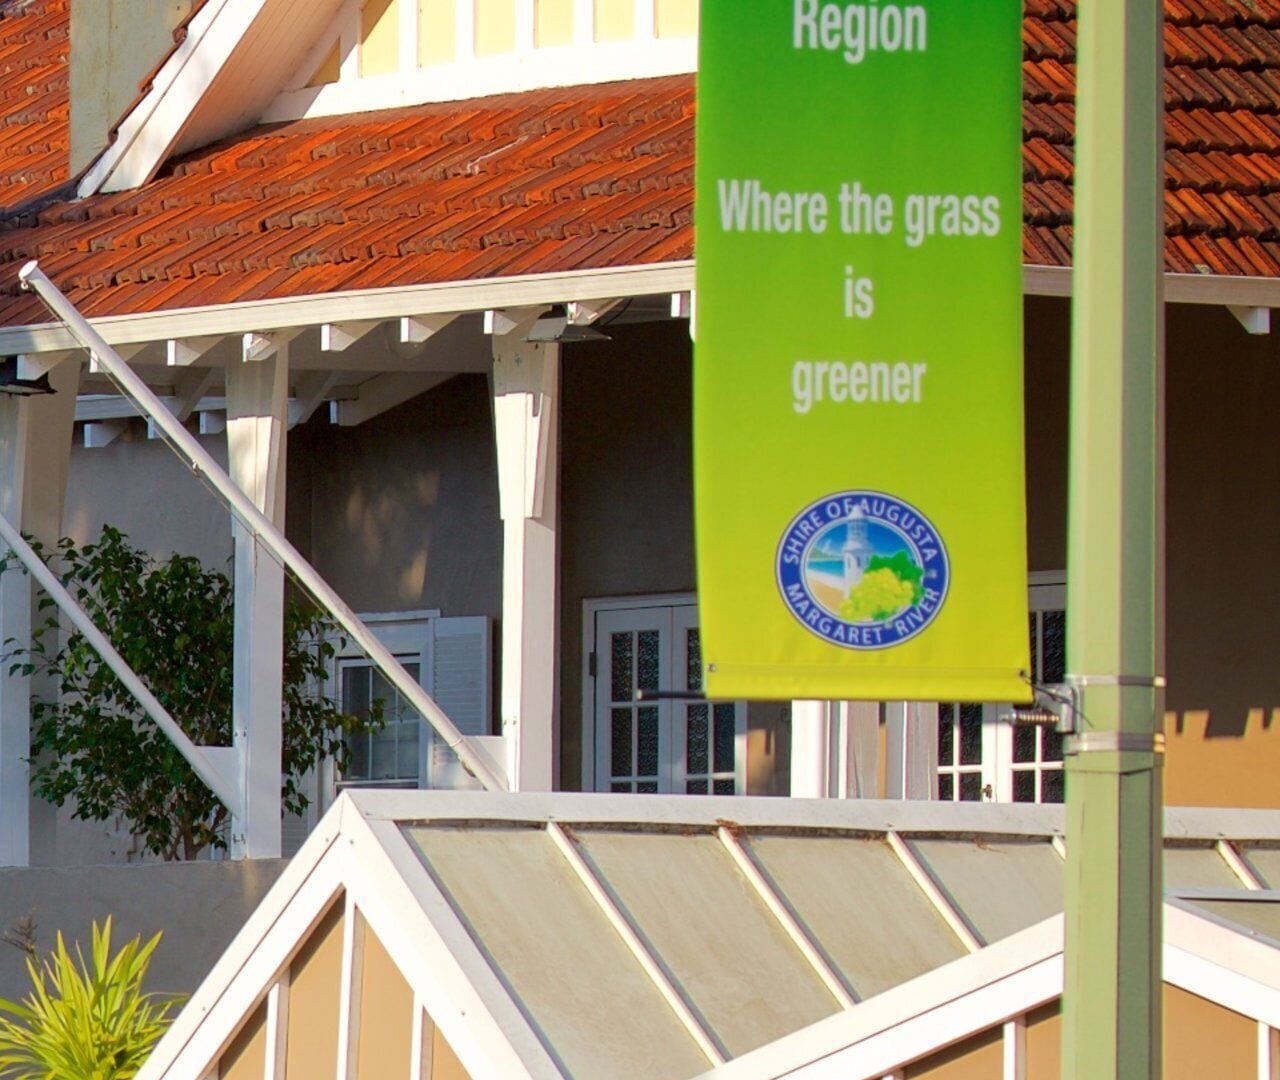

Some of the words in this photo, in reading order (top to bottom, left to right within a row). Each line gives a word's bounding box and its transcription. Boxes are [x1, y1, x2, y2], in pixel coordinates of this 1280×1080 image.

[793, 0, 928, 63] Region
[718, 180, 829, 233] Where
[840, 182, 894, 234] the
[904, 190, 1002, 247] grass
[843, 266, 874, 319] is
[792, 359, 927, 413] greener
[784, 511, 824, 565] SHIRE
[826, 497, 855, 519] OF
[858, 497, 938, 563] AUGUSTA
[786, 582, 884, 646] MARGARET
[894, 587, 940, 637] RIVER
